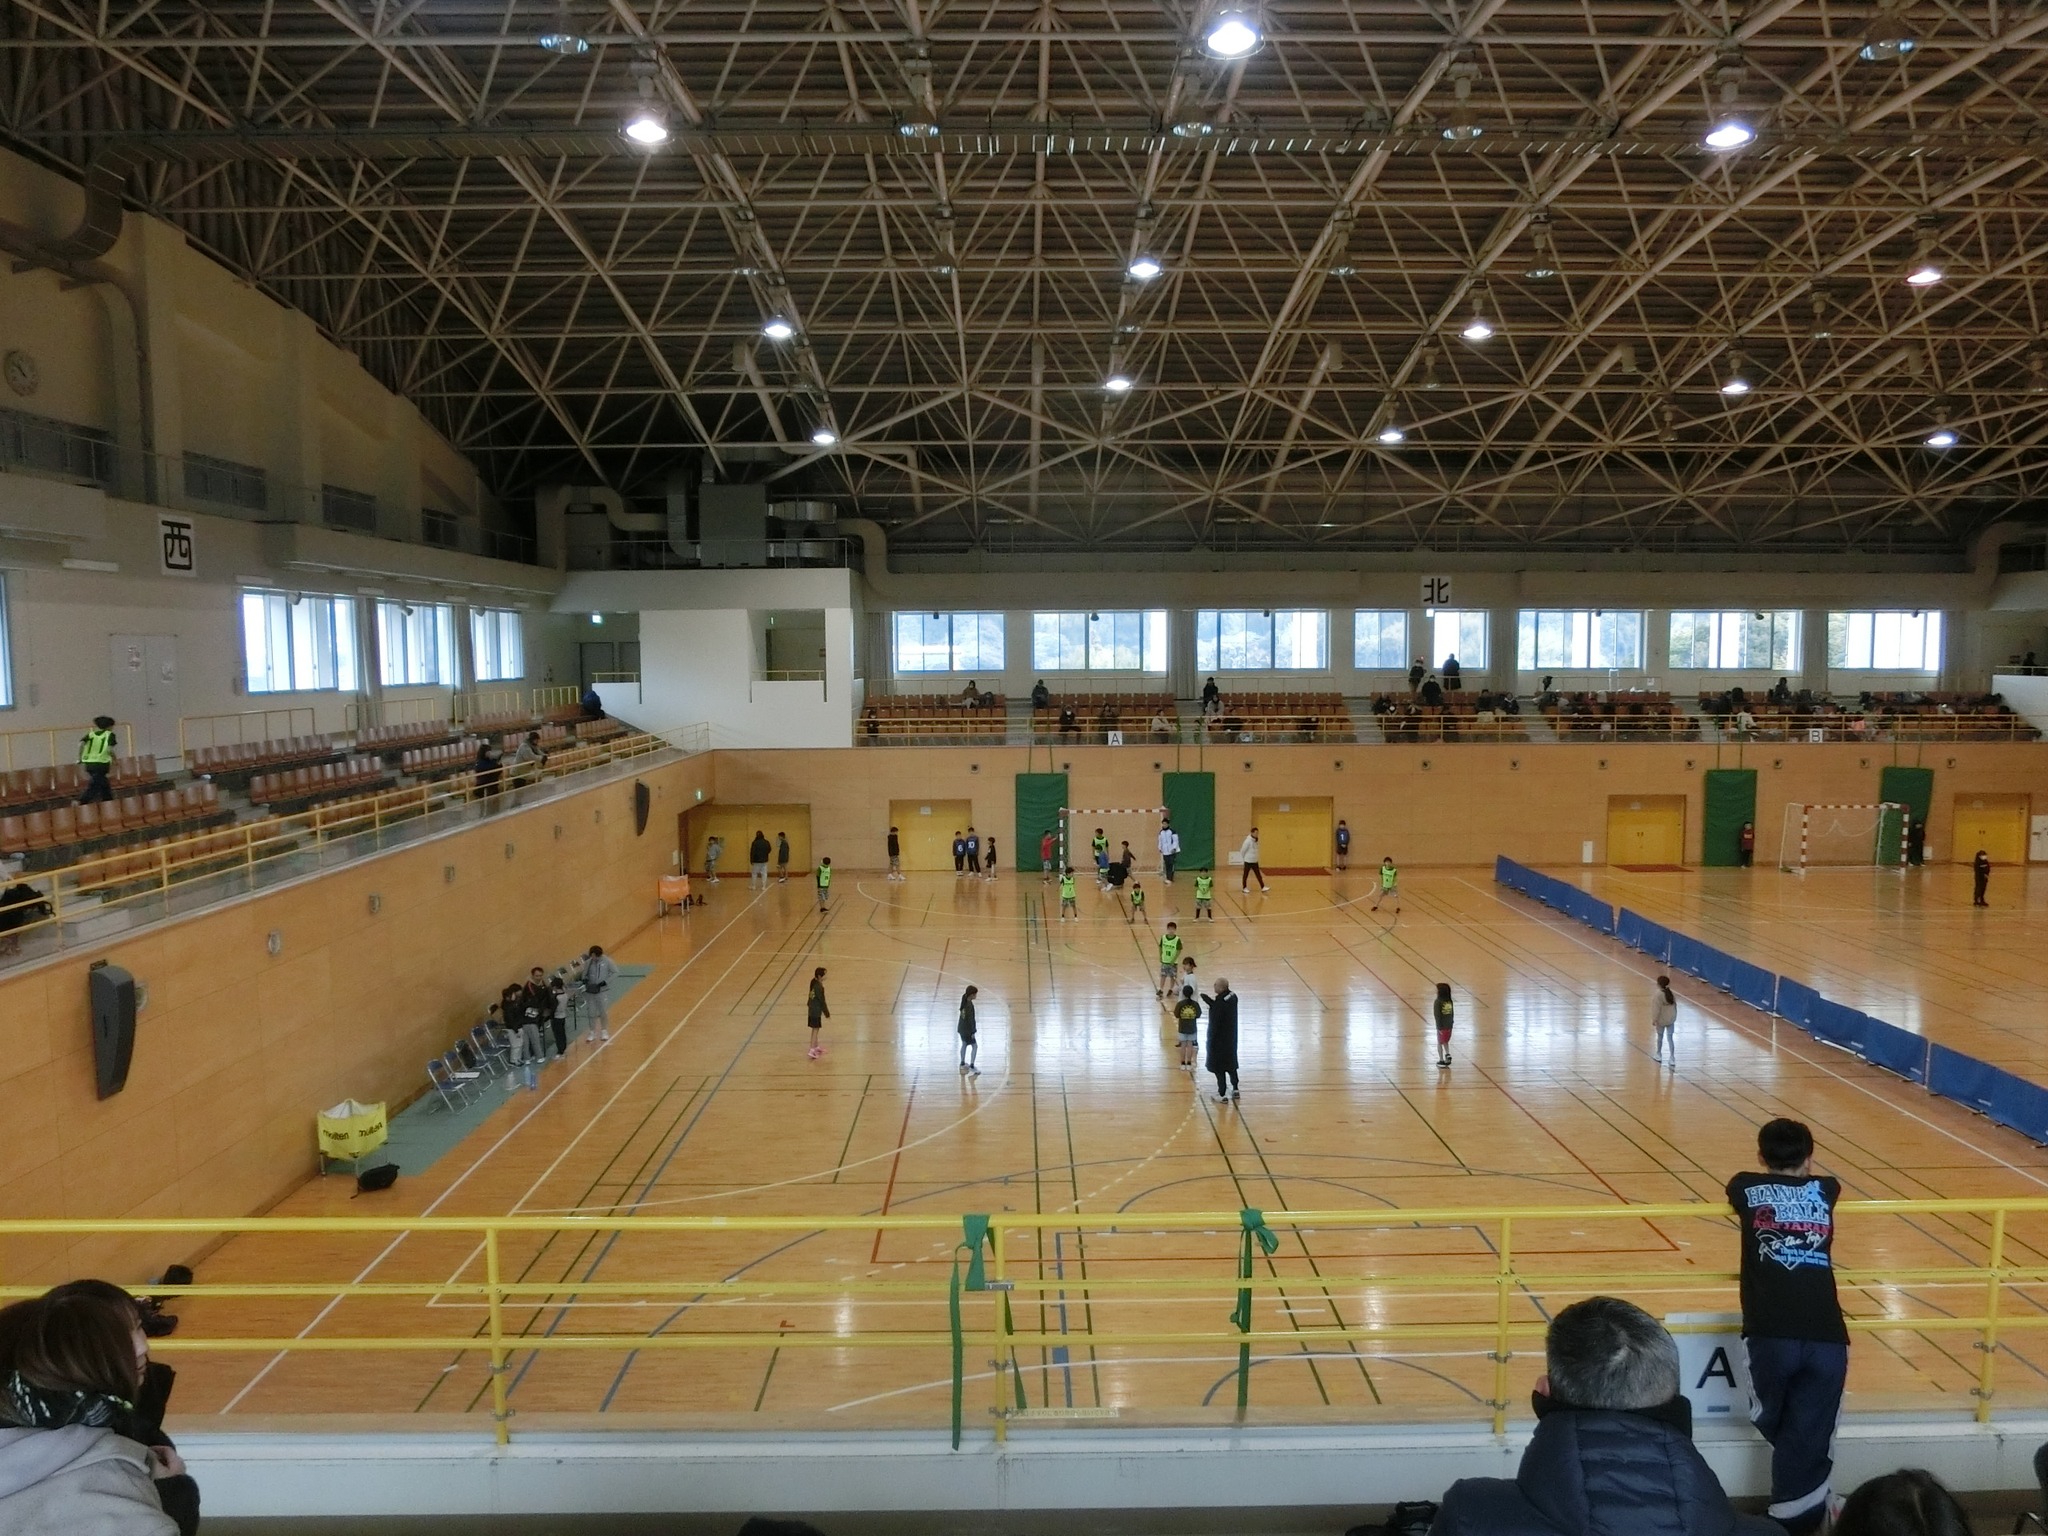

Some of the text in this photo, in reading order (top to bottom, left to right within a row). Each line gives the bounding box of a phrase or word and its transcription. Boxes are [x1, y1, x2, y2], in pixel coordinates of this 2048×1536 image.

[161, 520, 192, 570] 西
[1423, 578, 1449, 604] 北
[1110, 732, 1120, 745] A
[1811, 730, 1820, 743] B
[87, 736, 107, 754] 11
[957, 844, 964, 852] 6
[968, 841, 975, 849] 10
[1774, 1202, 1830, 1225] BALL
[1782, 1235, 1804, 1247] the
[1695, 1346, 1737, 1389] A
